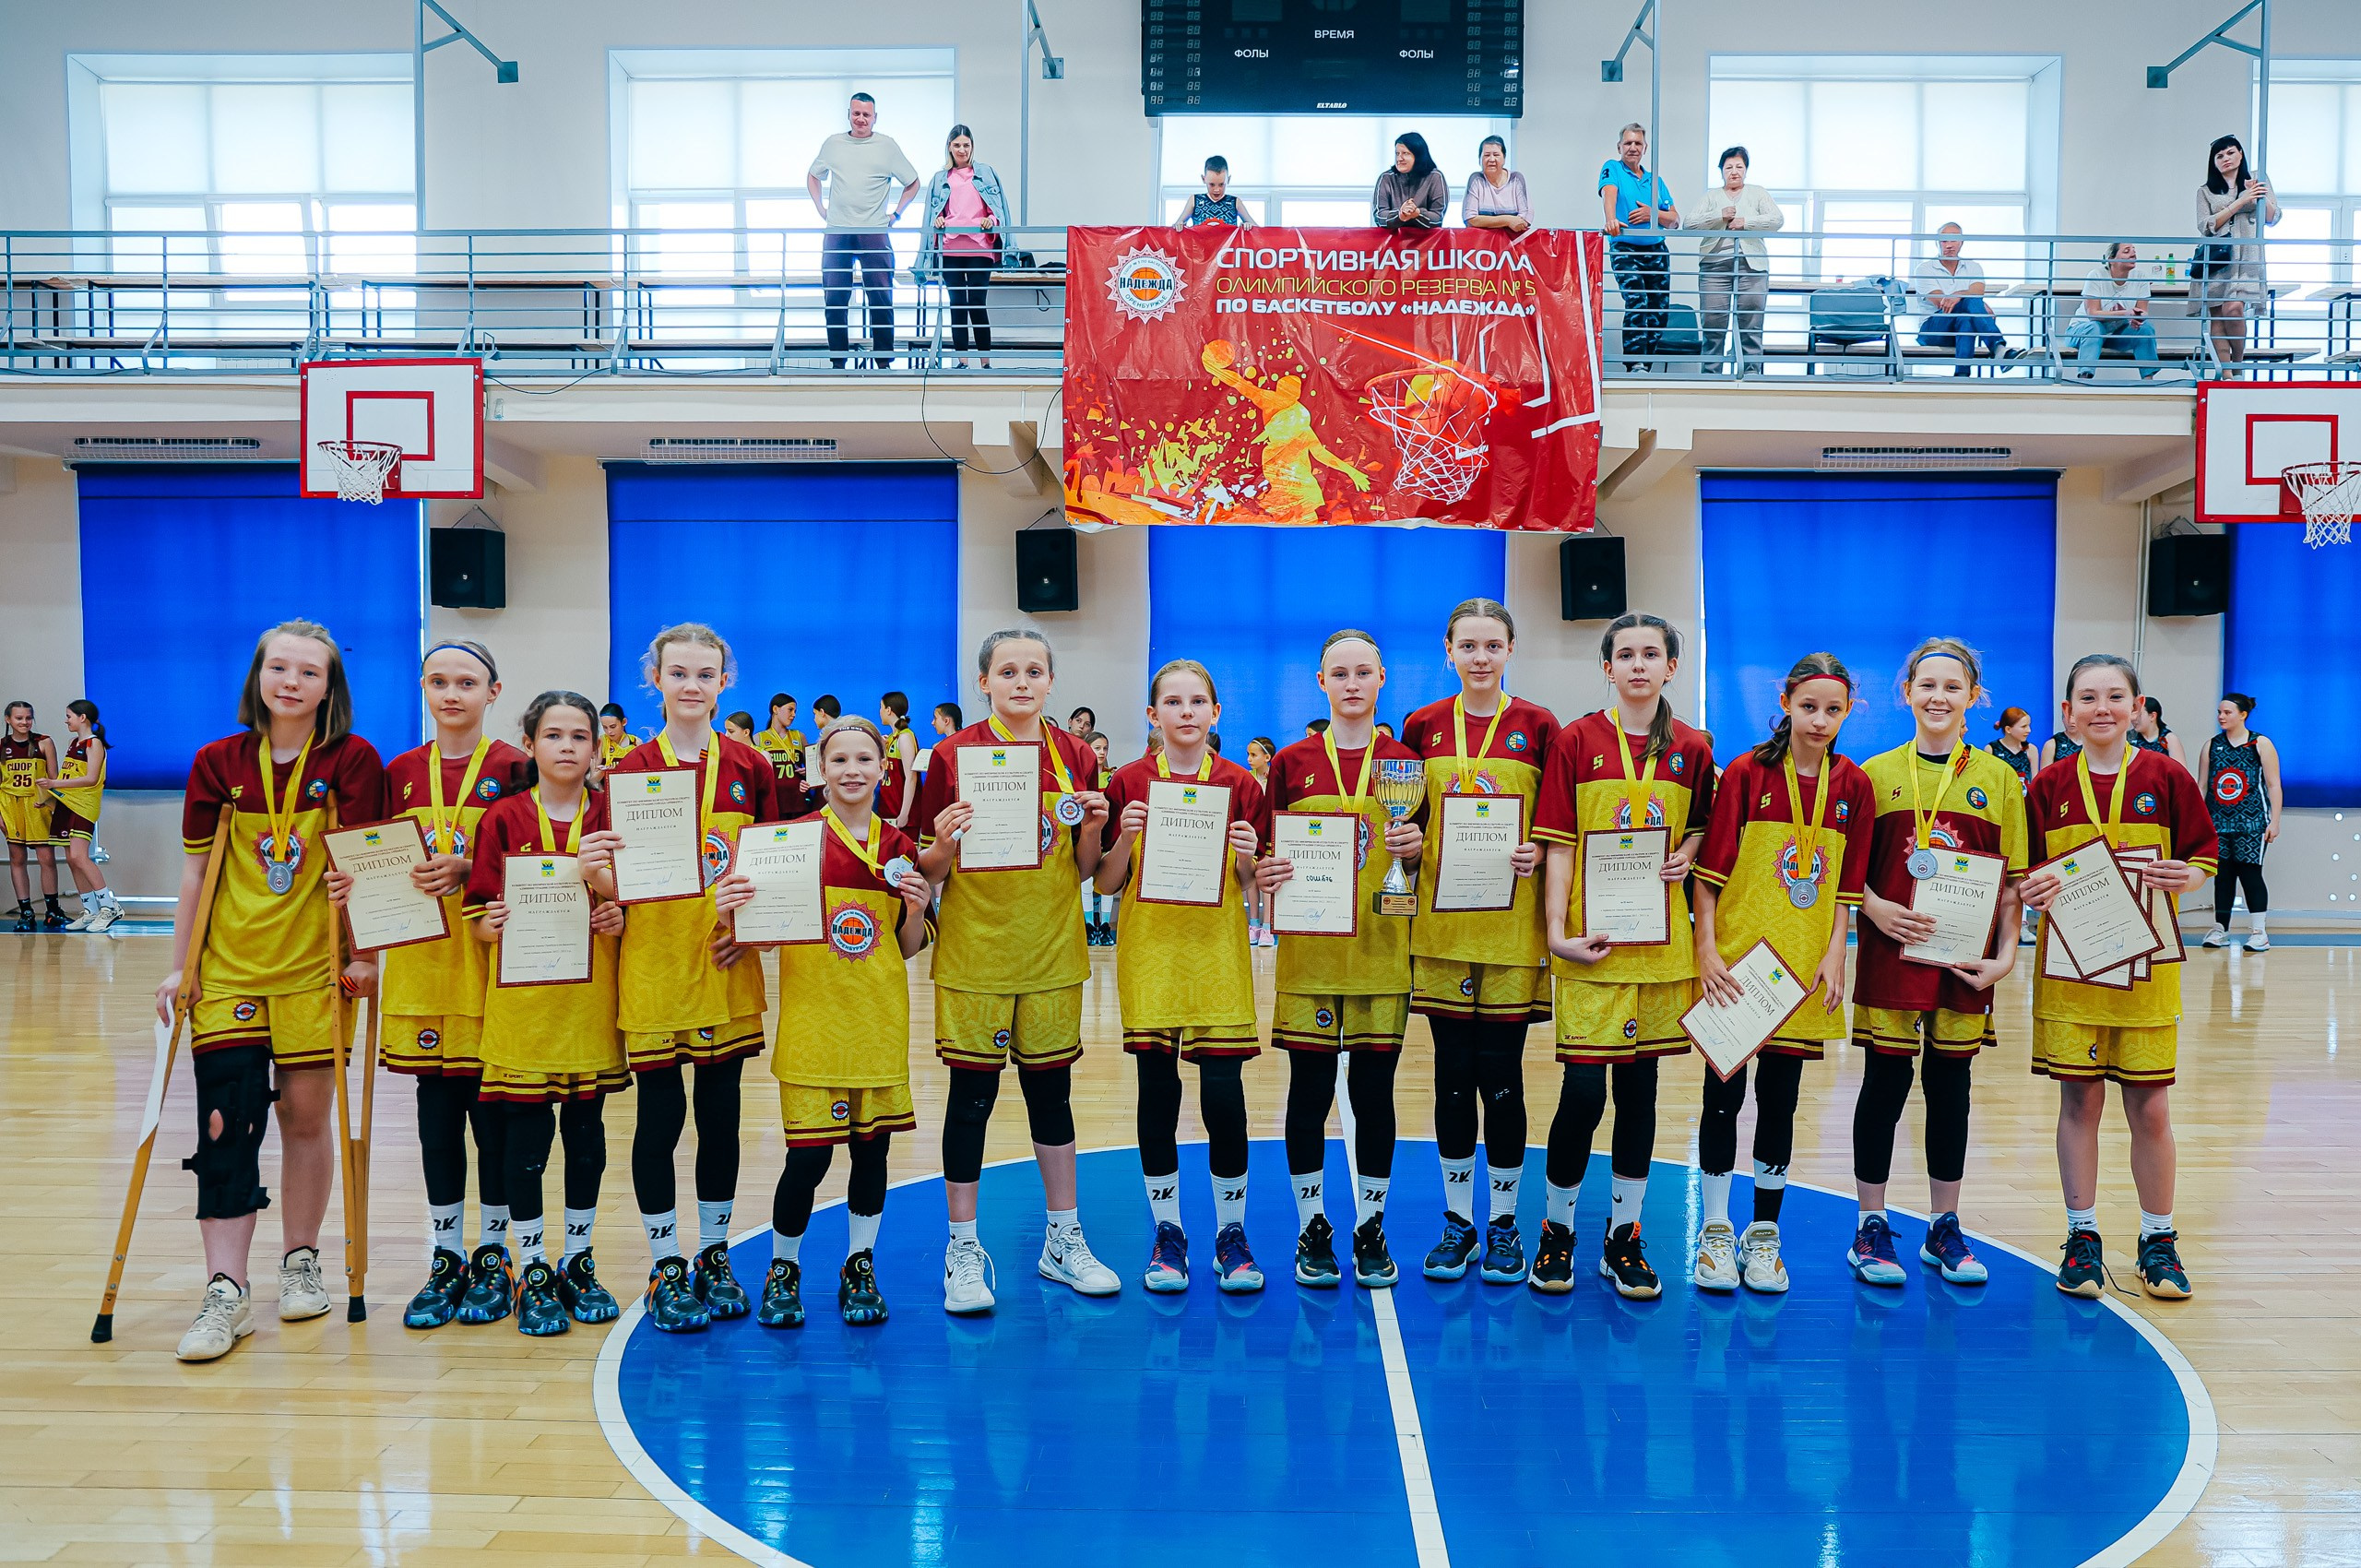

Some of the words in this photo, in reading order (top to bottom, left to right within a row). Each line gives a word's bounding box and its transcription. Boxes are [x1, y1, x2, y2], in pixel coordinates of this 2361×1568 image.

[1314, 30, 1355, 39] ВРЕМЯ
[1234, 49, 1269, 58] ФОЛЫ
[1399, 49, 1434, 59] ФОЛЫ
[1602, 169, 1609, 180] 3
[1216, 248, 1420, 270] СПОРТИВНАЯ
[1427, 249, 1535, 275] ШКОЛА
[1120, 277, 1173, 291] НАДЕЖДА
[1216, 277, 1397, 296] ОЛИМПИЙСКОГО
[1402, 279, 1498, 296] РЕЗЕРВА
[1525, 279, 1536, 296] 5
[1124, 293, 1168, 309] ОРЕНБУРЖЬЕ
[1216, 298, 1248, 314] ПО
[1252, 299, 1397, 316] БАСКЕТБОЛУ
[1401, 301, 1536, 318] «НАДЕЖДА»
[6, 762, 32, 772] СШОР
[776, 764, 795, 779] 70
[13, 773, 32, 788] 35
[973, 781, 1026, 793] ДИПЛОМ
[626, 807, 683, 822] ДИПЛОМ
[1160, 816, 1215, 830] ДИПЛОМ
[1455, 832, 1507, 842] ДИПЛОМ
[749, 853, 806, 867] ДИПЛОМ
[1288, 849, 1341, 860] ДИПЛОМ
[352, 854, 412, 873] ДИПЛОМ
[1598, 861, 1652, 873] ДИПЛОМ
[1929, 882, 1986, 899] ДИПЛОМ
[2058, 877, 2110, 907] ДИПЛОМ
[518, 892, 577, 905] ДИПЛОМ
[832, 923, 872, 938] НАДЕЖДА
[1738, 975, 1775, 1016] ДИПЛОМ
[1448, 1169, 1472, 1183] 2K
[1152, 1185, 1176, 1200] 2K
[1223, 1185, 1247, 1201] 2K
[1300, 1183, 1322, 1199] 2K
[1493, 1180, 1517, 1192] 2K
[1363, 1189, 1387, 1203] 2K
[433, 1215, 458, 1231] 2K
[567, 1222, 591, 1236] 2K
[522, 1229, 544, 1247] 2K
[649, 1222, 675, 1240] 2K
